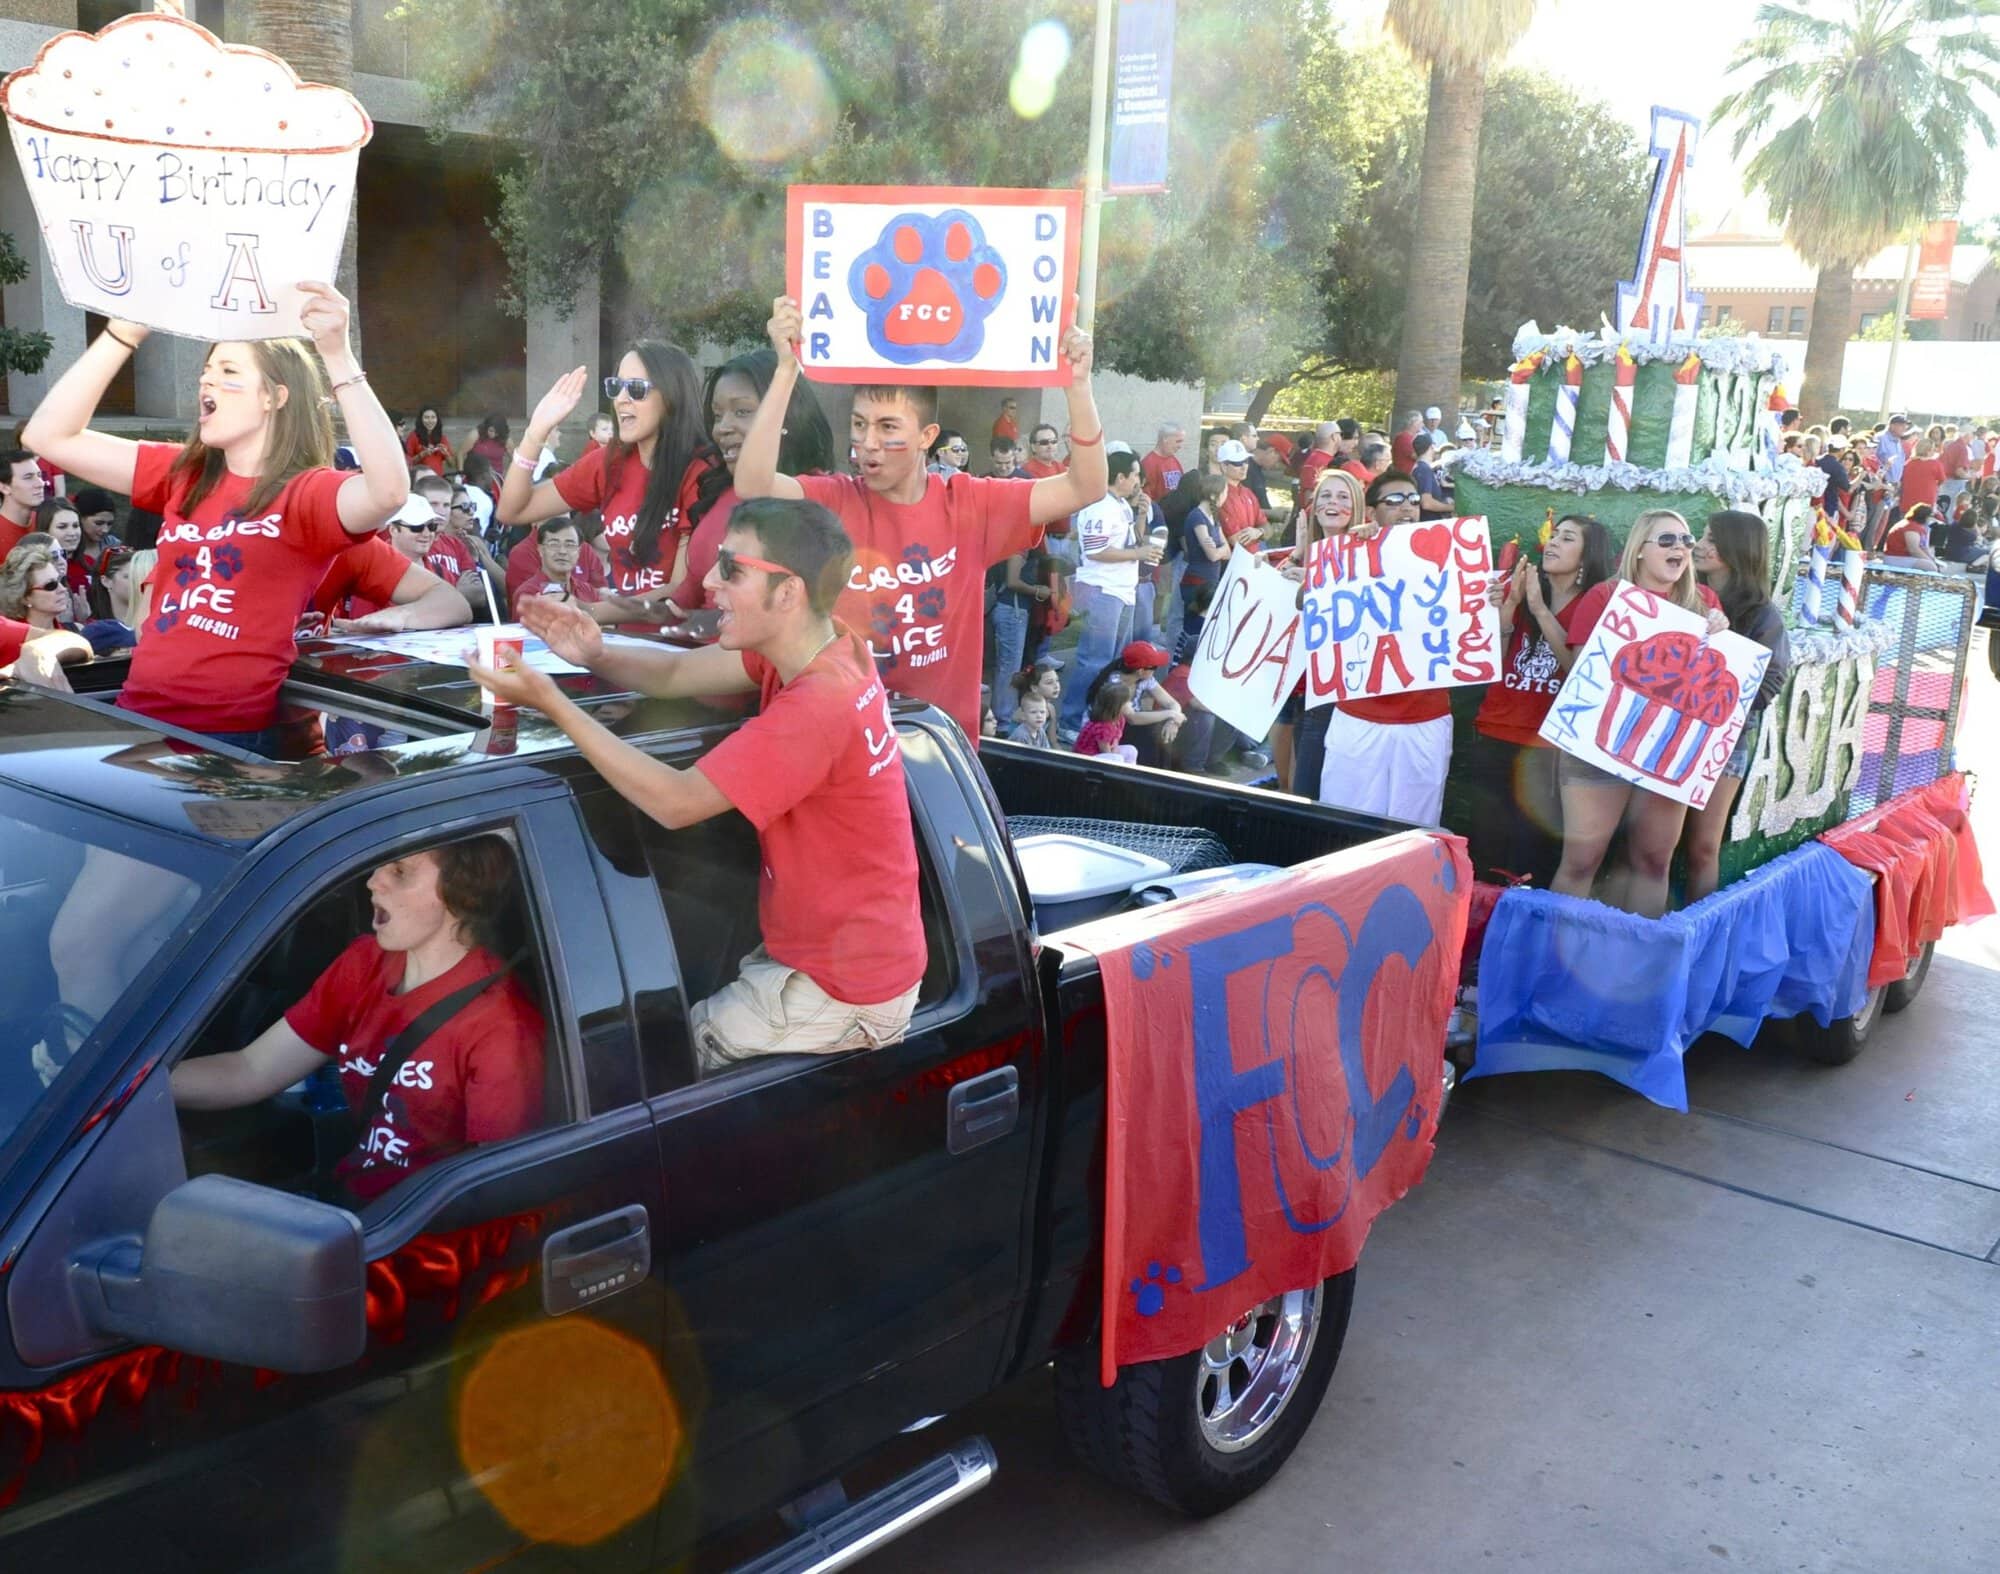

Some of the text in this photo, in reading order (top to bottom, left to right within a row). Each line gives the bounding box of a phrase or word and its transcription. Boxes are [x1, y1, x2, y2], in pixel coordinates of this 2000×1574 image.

[27, 136, 336, 232] Happy Birthday
[70, 219, 277, 313] U of A
[809, 209, 834, 359] BEAR
[1030, 213, 1057, 363] DOWN
[1084, 519, 1103, 534] 44
[195, 546, 213, 579] 4
[160, 583, 236, 614] LIFE
[895, 594, 915, 623] 4
[1304, 579, 1406, 651] B-DAY
[866, 624, 944, 657] LIFE
[1311, 632, 1415, 700] U of A
[1505, 673, 1561, 694] CATS
[1547, 636, 1612, 750] HAPPY
[360, 1127, 410, 1161] IFE
